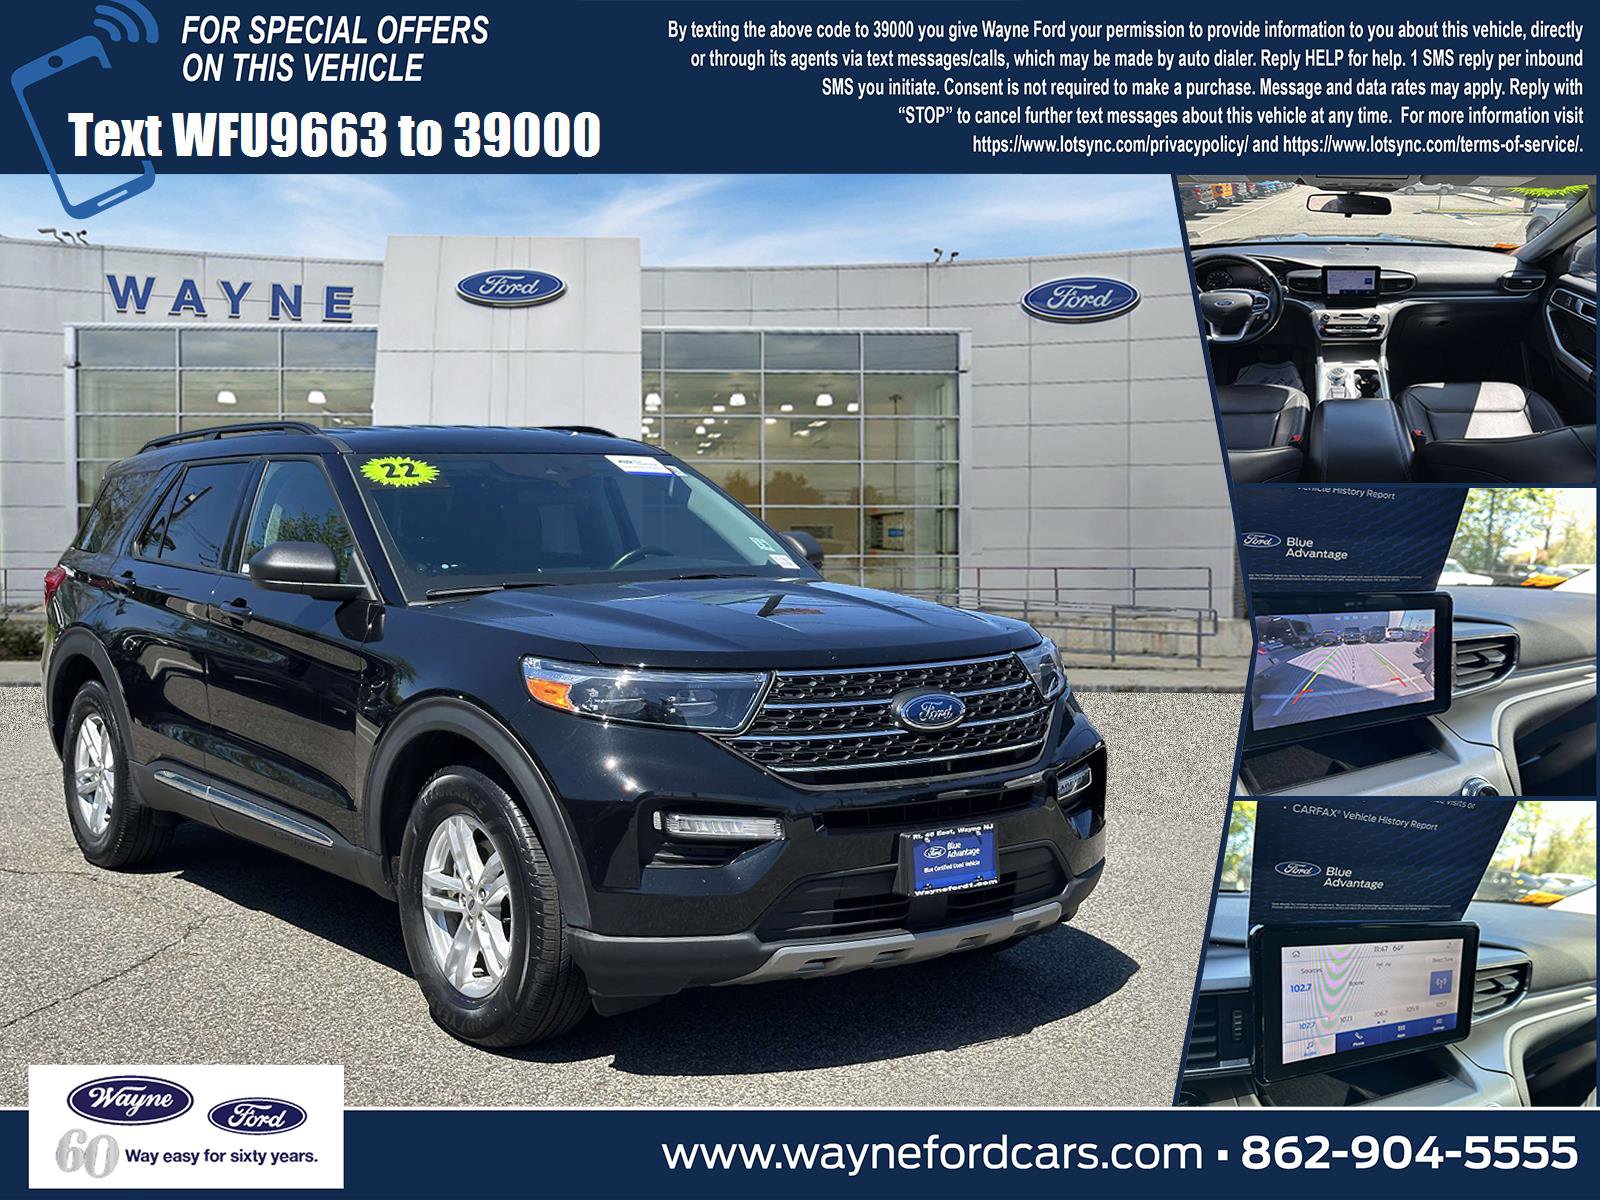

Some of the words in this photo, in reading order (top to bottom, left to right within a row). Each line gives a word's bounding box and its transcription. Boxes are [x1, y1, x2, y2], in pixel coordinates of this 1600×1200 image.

[479, 275, 540, 295] Ford
[106, 274, 354, 322] WAYNE
[1047, 284, 1114, 309] Ford
[380, 462, 420, 478] 22
[1367, 490, 1396, 500] Report
[1243, 534, 1273, 546] Ford
[1286, 536, 1314, 548] Blue
[1285, 548, 1348, 561] Advantage
[919, 701, 954, 721] Ford
[1343, 811, 1377, 824] Vehicle
[1378, 815, 1410, 828] History
[1410, 820, 1439, 832] Report
[947, 848, 981, 858] Advantage
[1283, 862, 1313, 875] Ford
[1325, 866, 1352, 878] Blue
[1323, 877, 1385, 891] Advantage
[1290, 984, 1312, 993] 102.7
